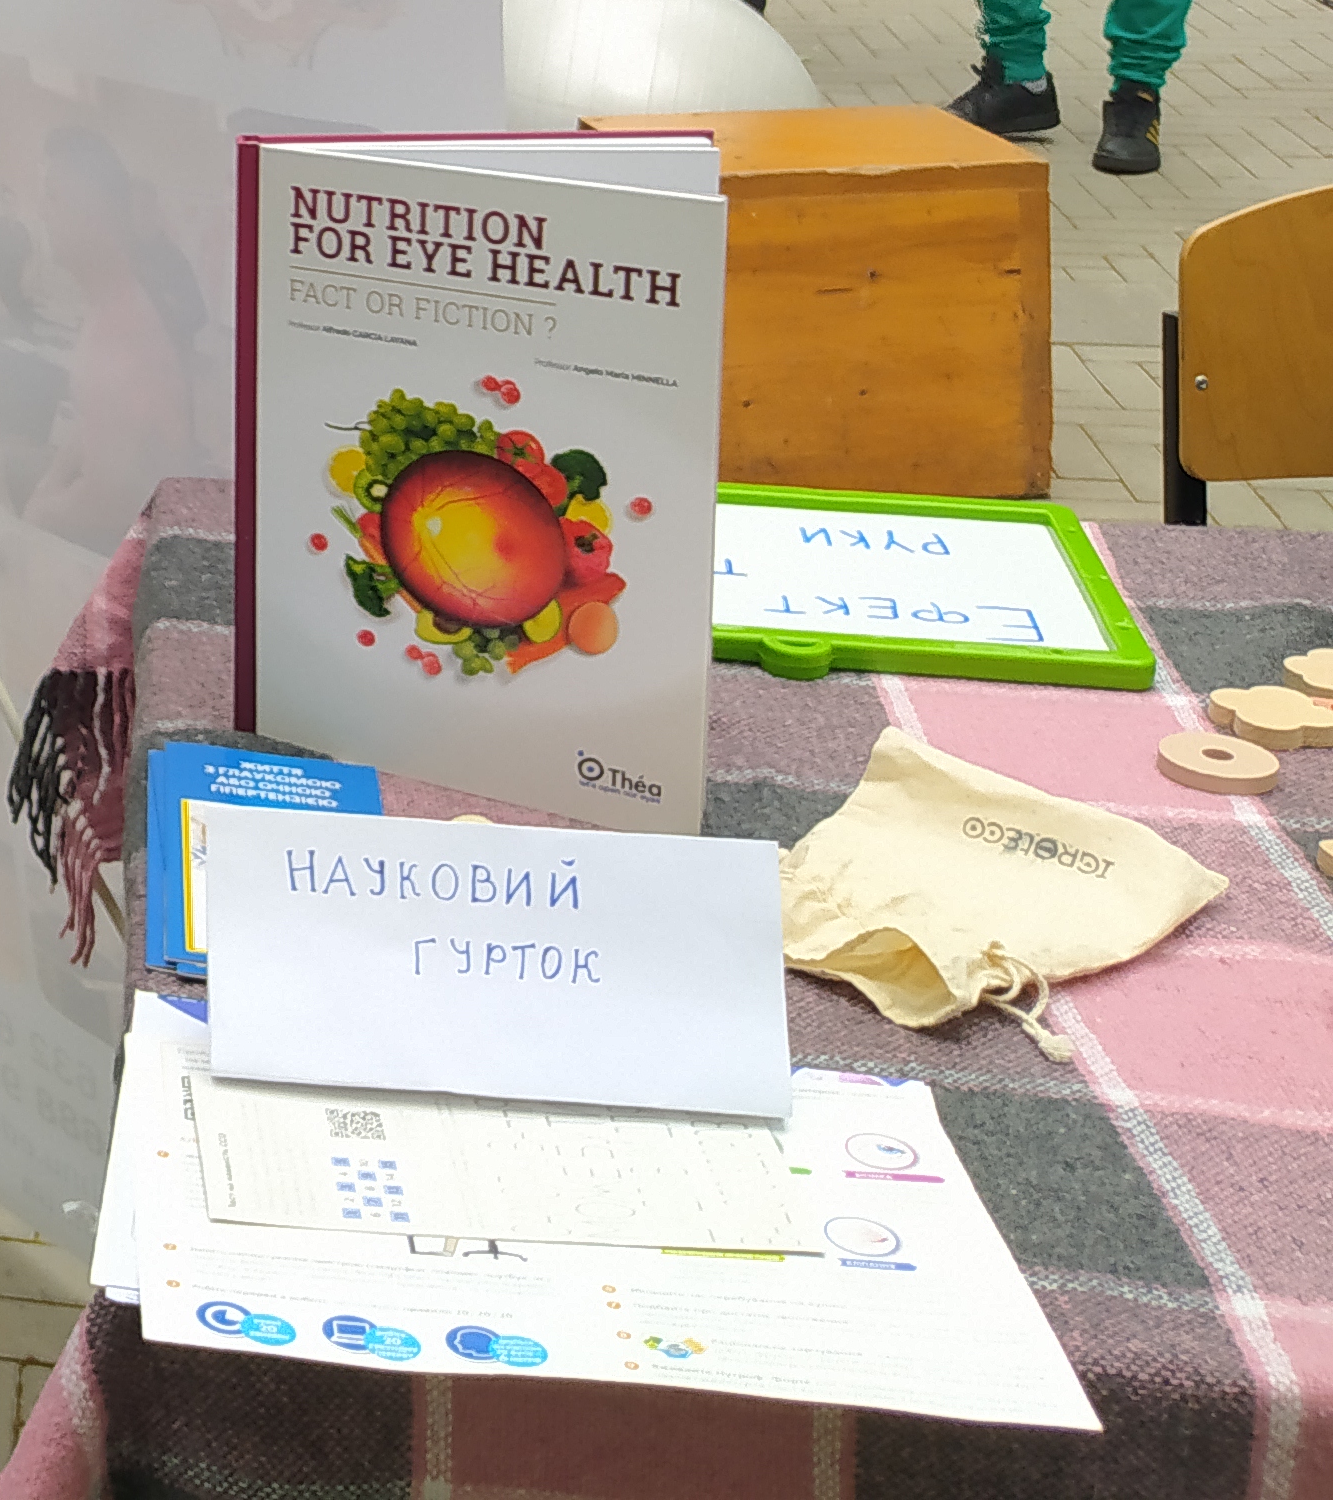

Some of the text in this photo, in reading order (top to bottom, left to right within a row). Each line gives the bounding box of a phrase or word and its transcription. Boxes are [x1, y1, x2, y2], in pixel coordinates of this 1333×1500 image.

[289, 184, 549, 252] NUTRITION
[289, 221, 683, 309] FOR EYE HEALTH
[289, 277, 559, 341] FACT OR FICTION ?
[798, 526, 951, 556] РУКИ
[763, 595, 1044, 643] ЕФЕКТ
[215, 775, 333, 798] АБО ОЧНОЮ
[218, 766, 342, 790] ГЛАУКОМОЮ
[239, 760, 304, 777] ЖИТТЯ
[607, 766, 662, 798] Théa
[210, 784, 339, 808] ГІПЕРТЕНЗІЄЮ
[285, 848, 581, 911] НАУКОВИЙ
[412, 937, 602, 985] ГУРТОК
